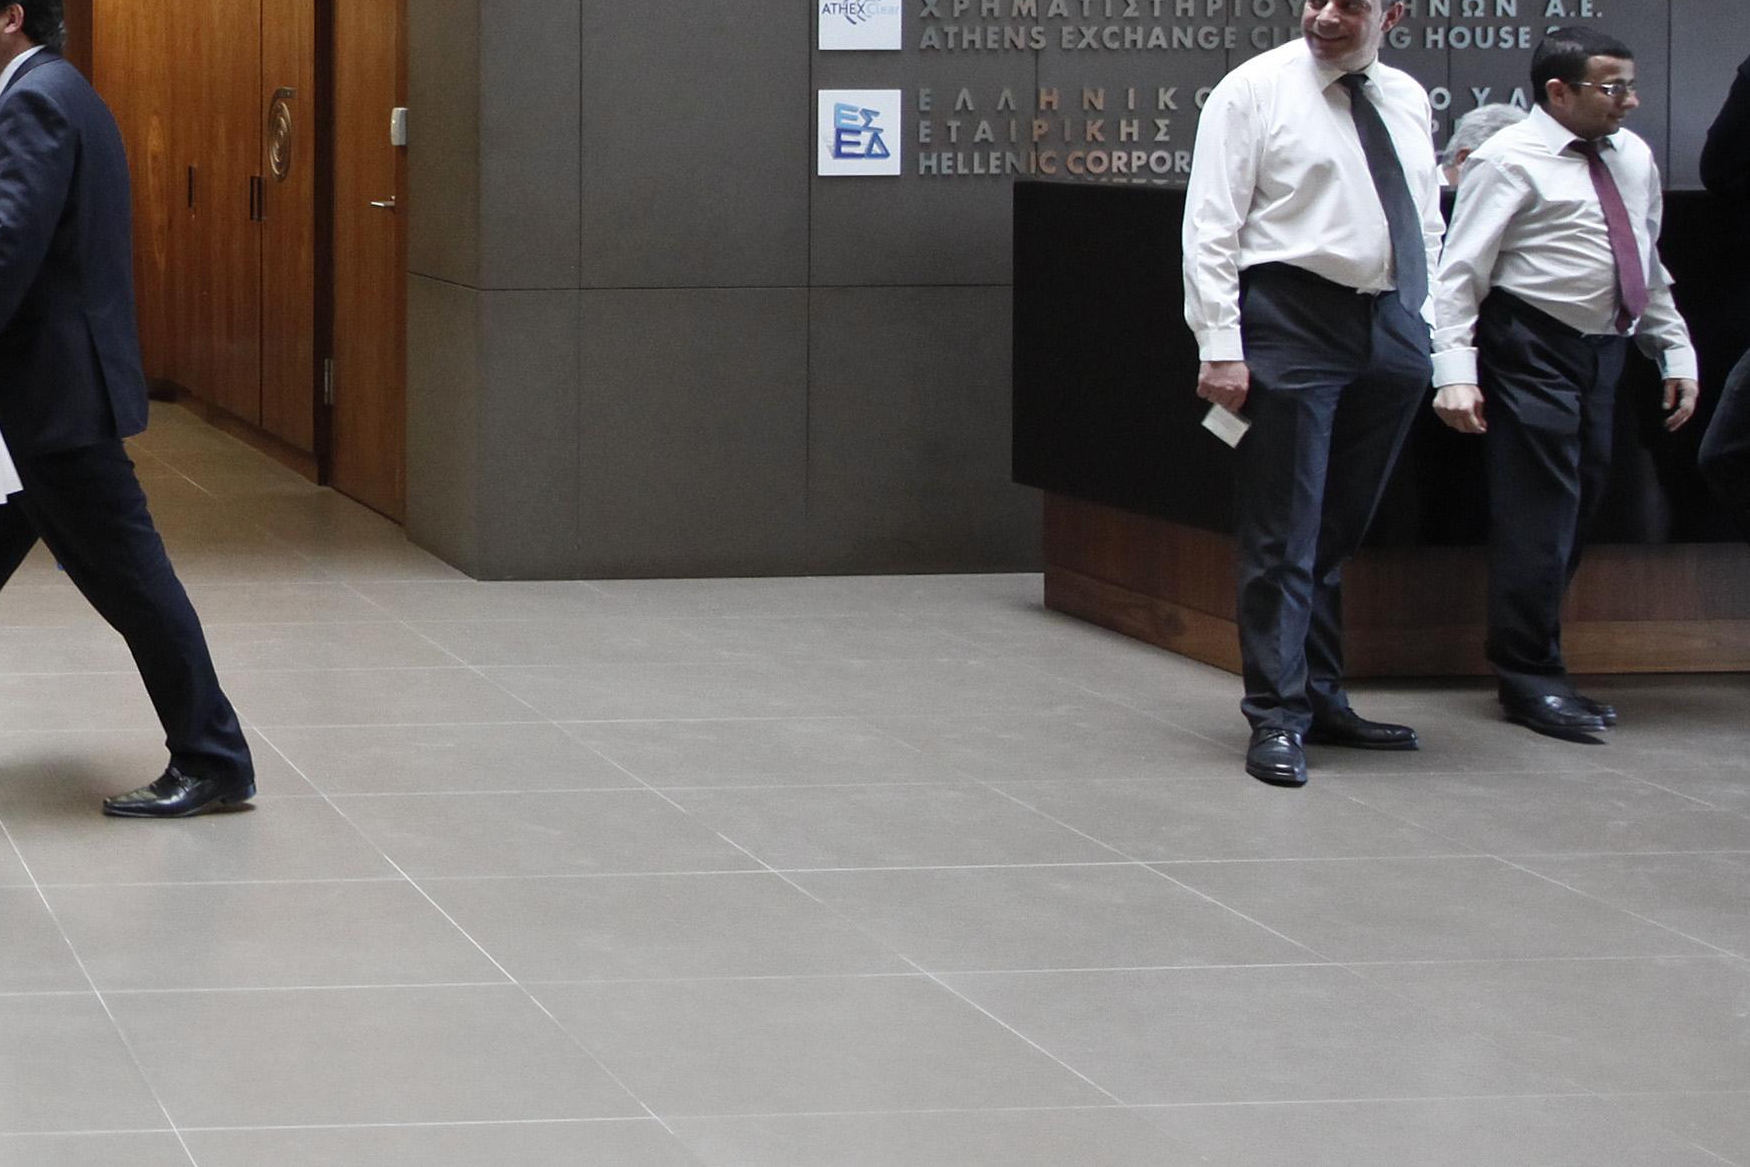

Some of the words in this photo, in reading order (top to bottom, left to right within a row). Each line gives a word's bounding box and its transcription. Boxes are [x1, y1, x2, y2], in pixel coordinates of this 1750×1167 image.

[919, 25, 1048, 50] ATHENS
[1060, 25, 1237, 50] EXCHANGE
[1425, 25, 1532, 49] HOUSE
[918, 119, 1171, 143] ΕΤΑΙΡΙΚΗΣ
[918, 150, 1058, 175] HELLENIC
[1065, 149, 1191, 174] CORPOR
